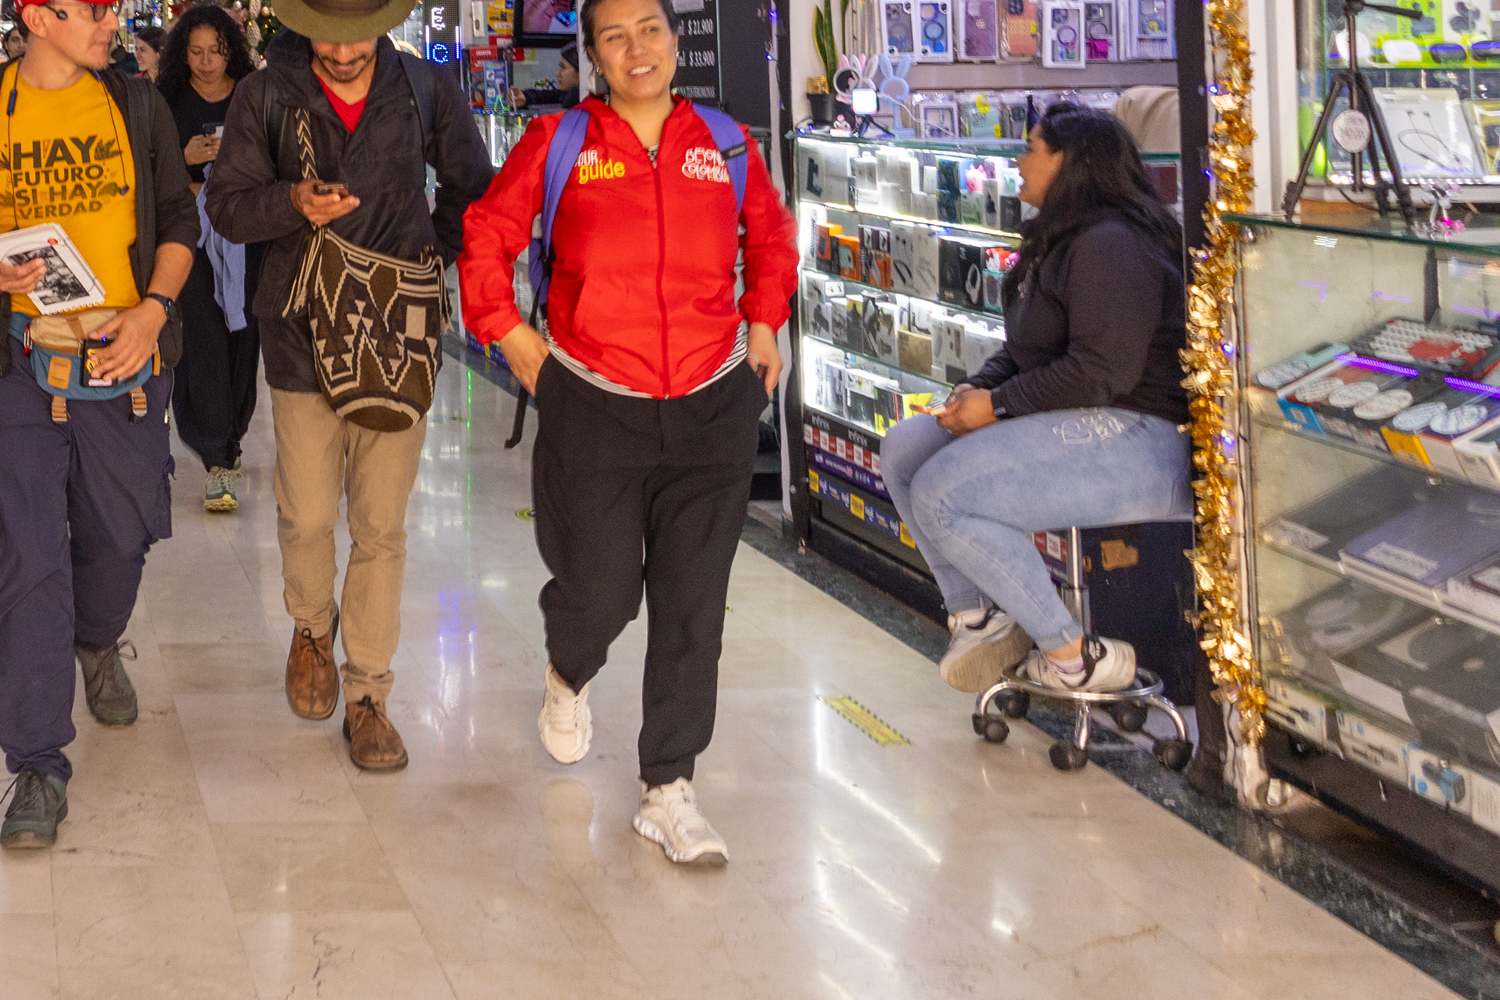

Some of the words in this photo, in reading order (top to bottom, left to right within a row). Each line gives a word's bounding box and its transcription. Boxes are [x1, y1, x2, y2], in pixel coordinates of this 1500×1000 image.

[12, 134, 98, 170] HAY
[12, 164, 105, 188] FUTURO
[578, 158, 626, 185] guide
[15, 187, 38, 207] SI
[49, 182, 104, 203] HAY
[17, 200, 104, 220] VERDAD
